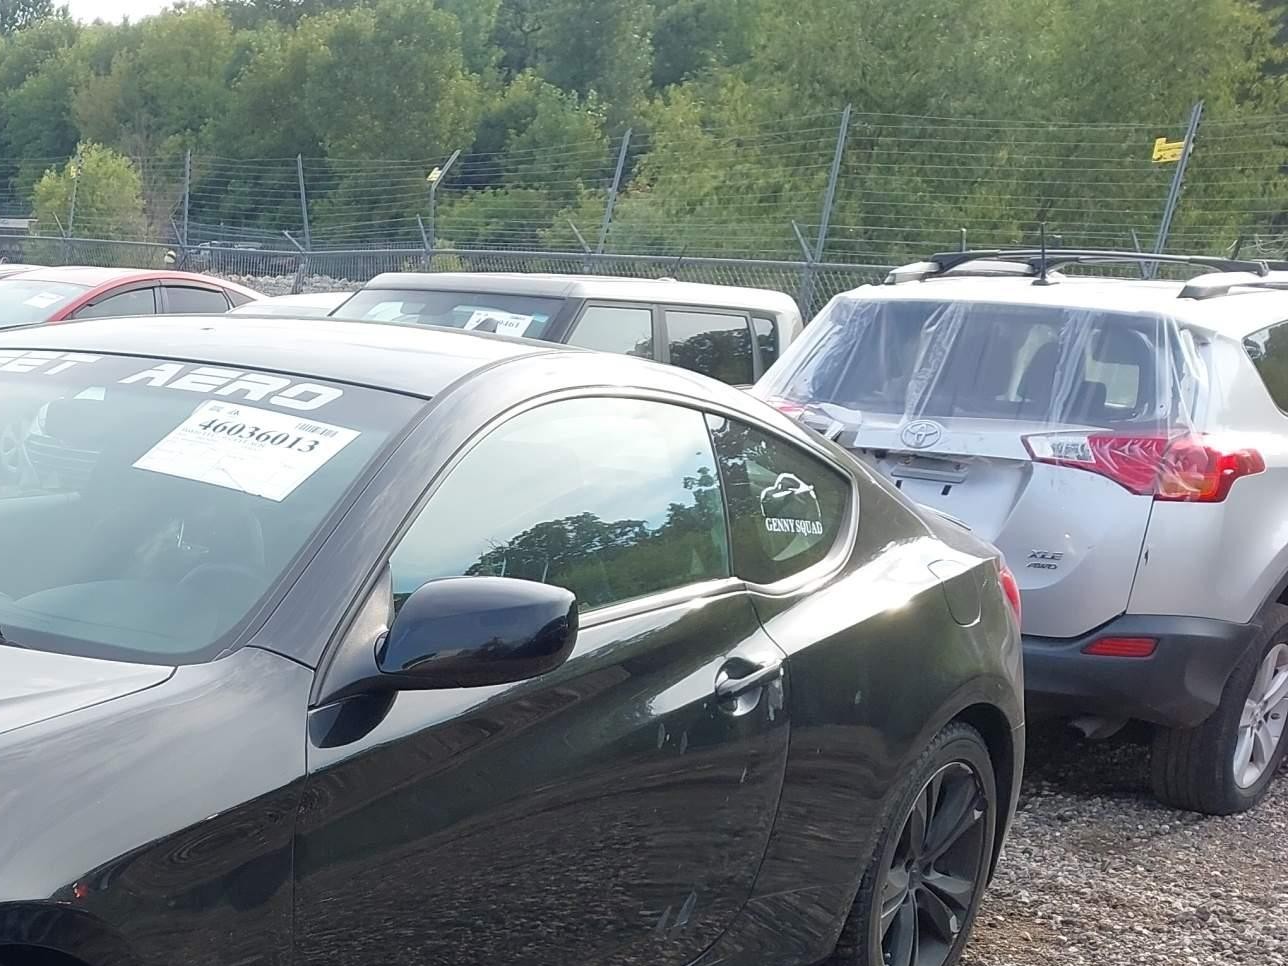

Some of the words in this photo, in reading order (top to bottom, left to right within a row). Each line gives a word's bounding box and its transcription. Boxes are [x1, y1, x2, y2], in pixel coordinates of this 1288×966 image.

[117, 363, 344, 411] AERO
[198, 418, 319, 453] 46036013
[765, 517, 795, 532] GENNY
[795, 519, 823, 536] SQUAD
[1027, 549, 1064, 560] XLE
